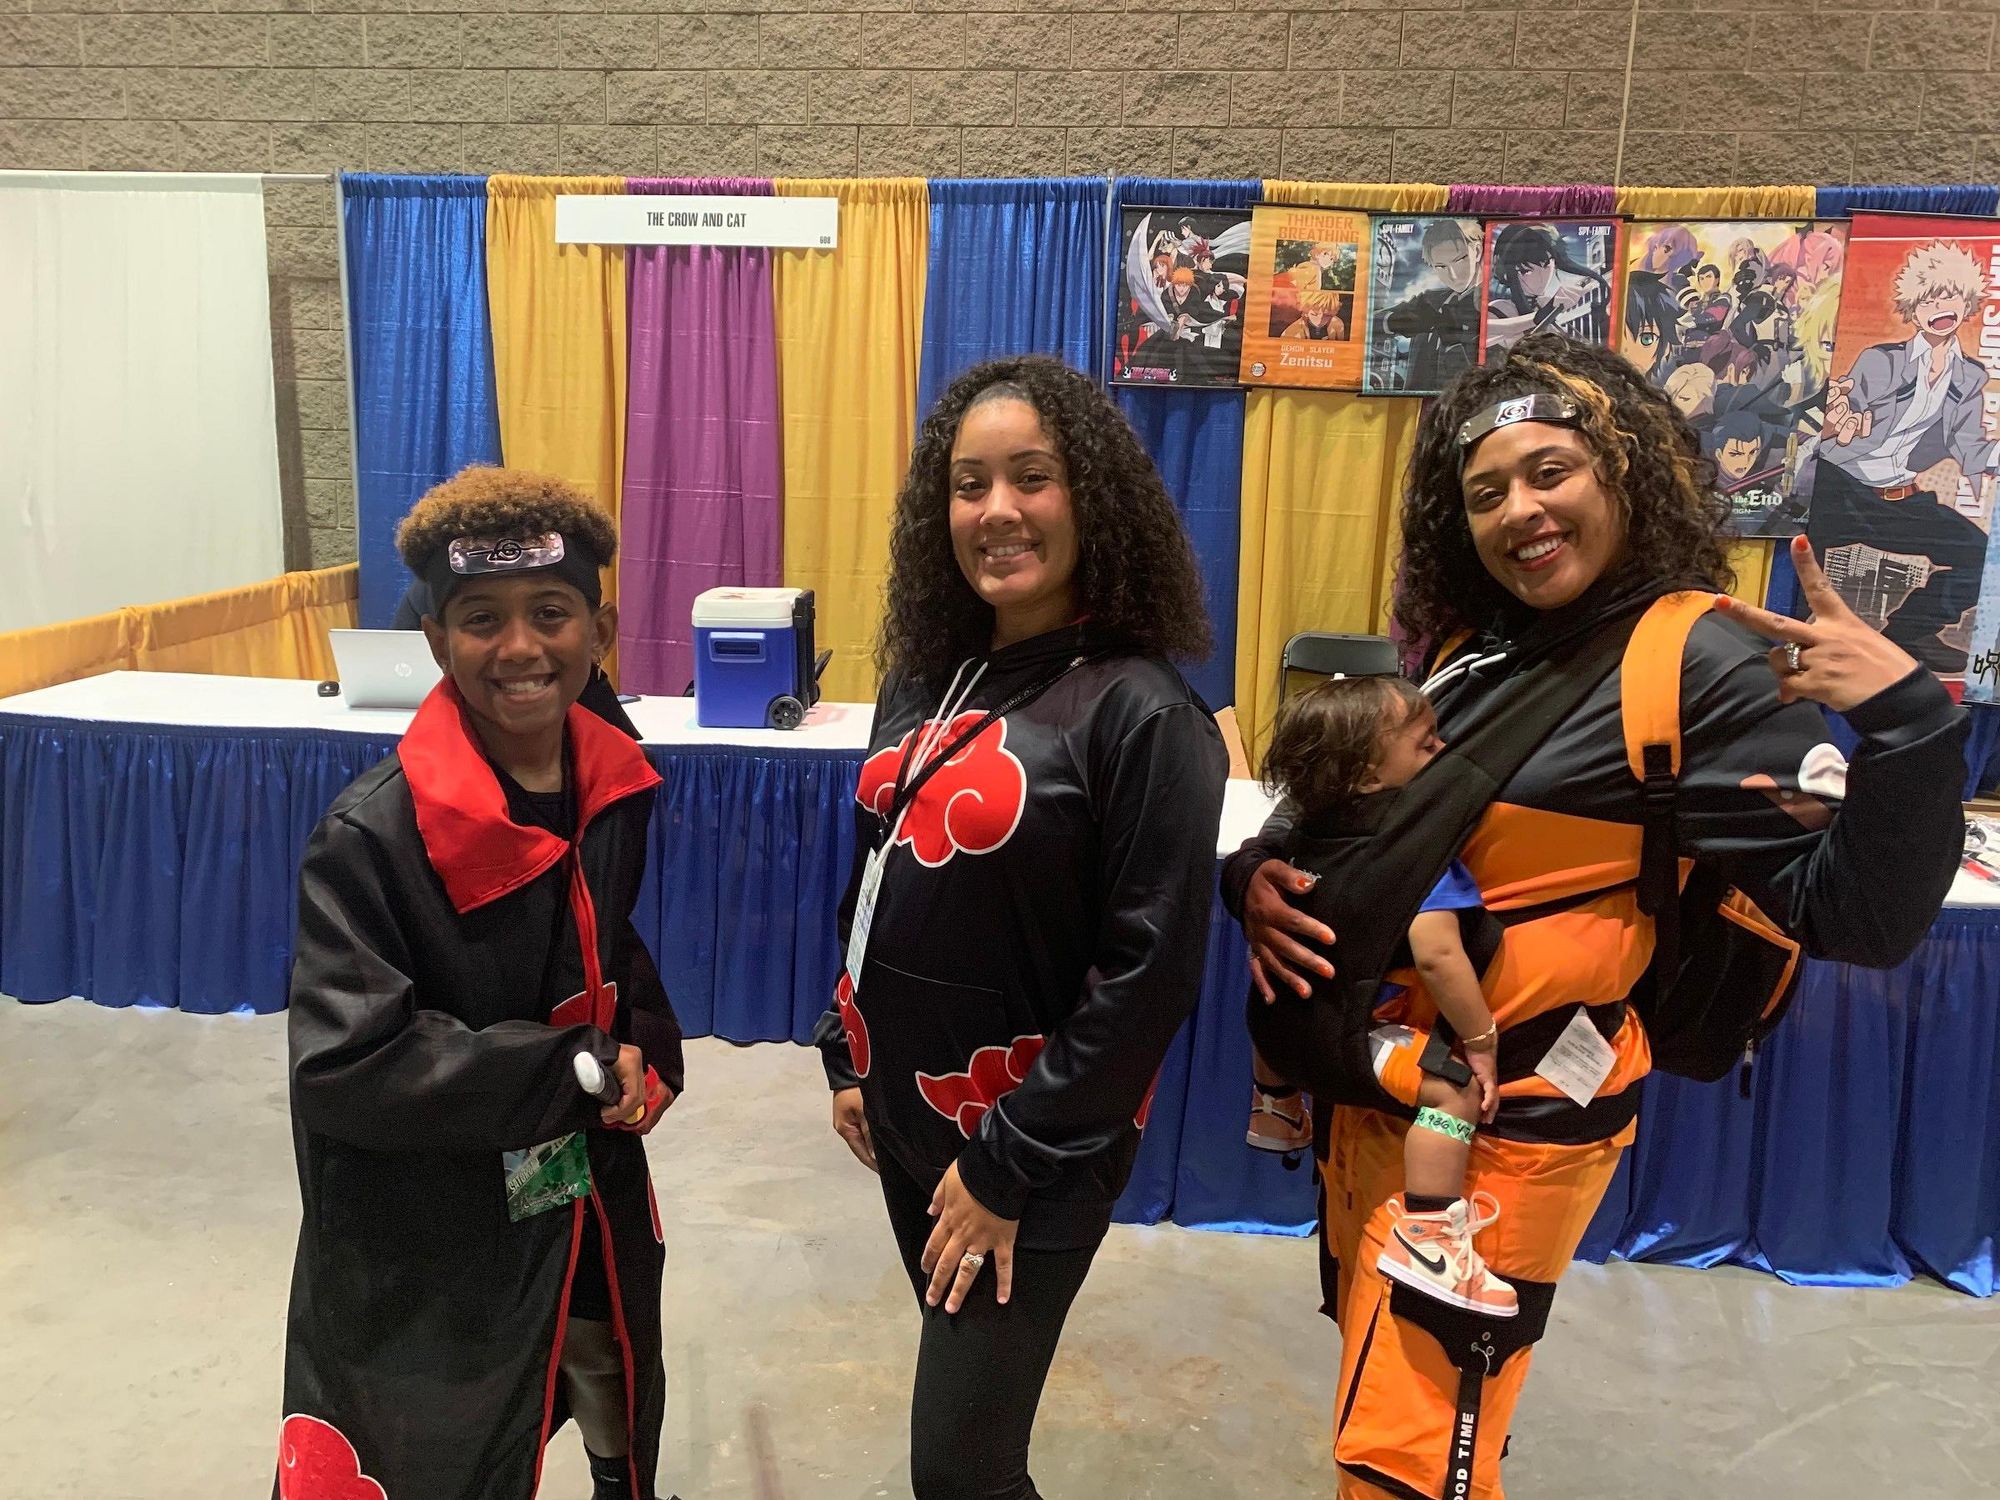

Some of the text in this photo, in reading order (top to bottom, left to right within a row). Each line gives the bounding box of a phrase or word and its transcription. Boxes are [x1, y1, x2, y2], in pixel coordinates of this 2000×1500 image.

[647, 211, 747, 228] THE CROW AND CAT
[1286, 212, 1354, 230] THUNDER
[1278, 226, 1360, 243] BREATHING
[1280, 344, 1335, 354] DEMON SLAYER
[1279, 352, 1334, 369] Zenitsu
[1734, 494, 1748, 504] the
[1747, 488, 1783, 506] End
[1457, 1412, 1475, 1459] TIME
